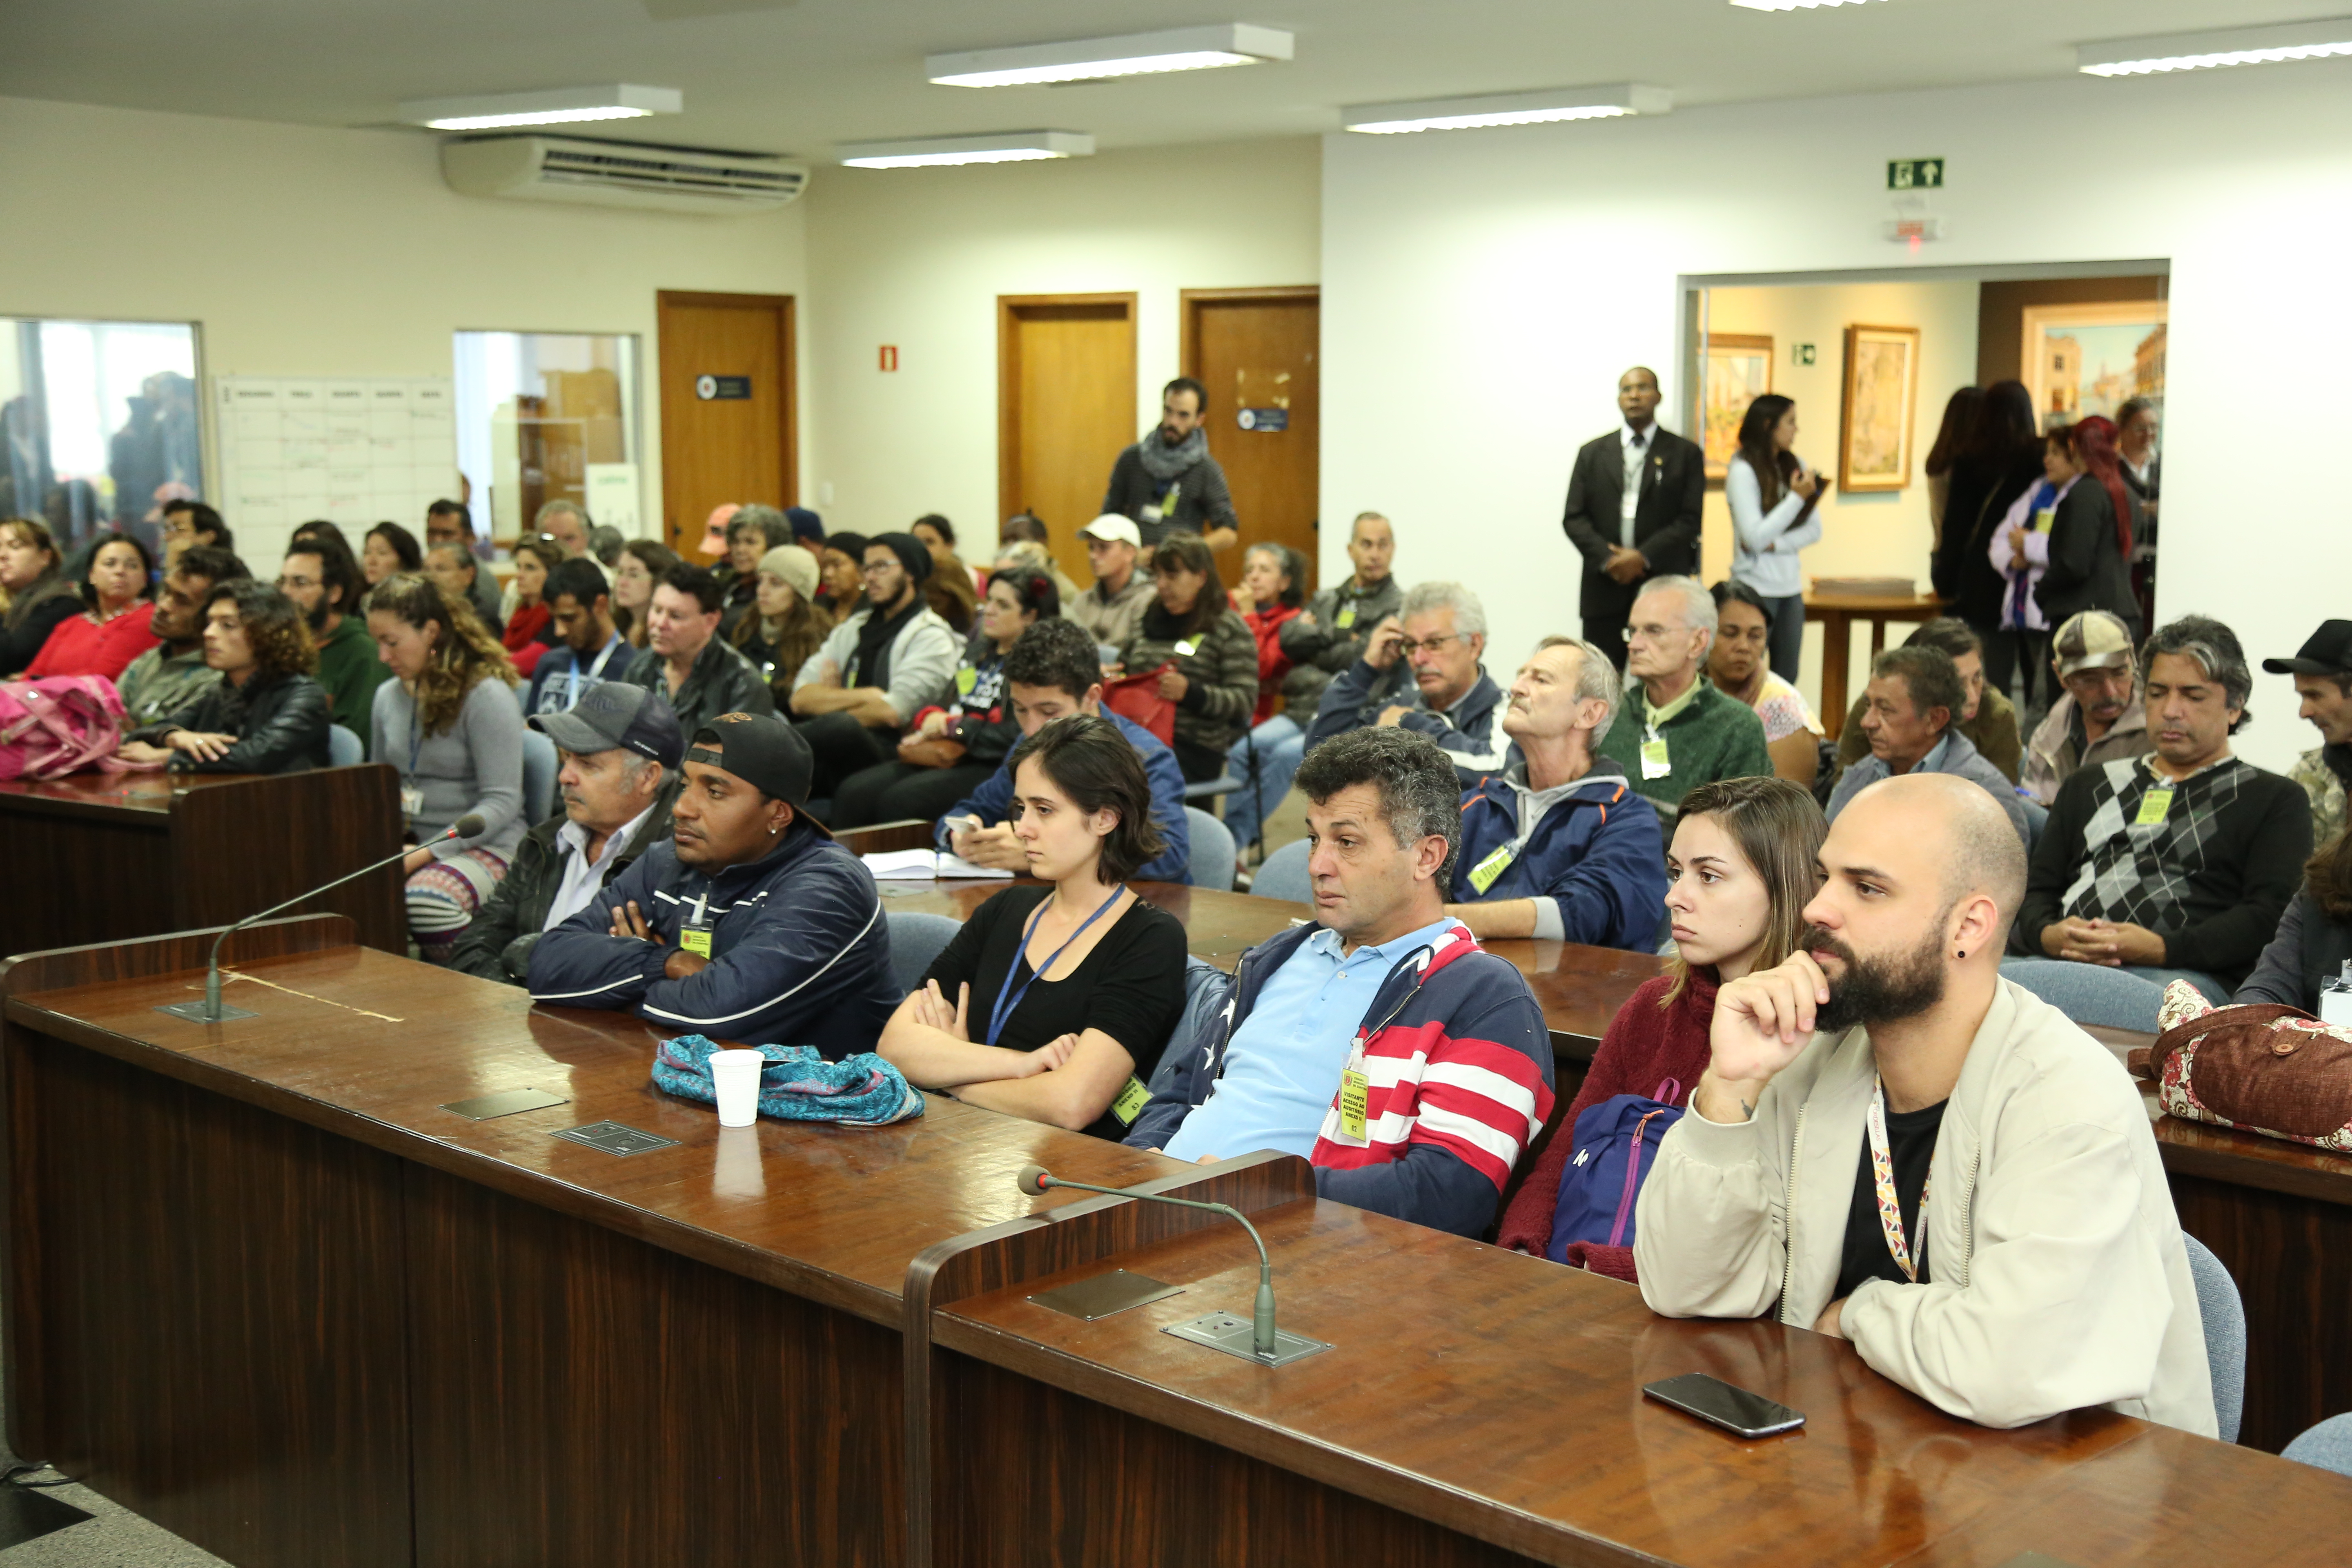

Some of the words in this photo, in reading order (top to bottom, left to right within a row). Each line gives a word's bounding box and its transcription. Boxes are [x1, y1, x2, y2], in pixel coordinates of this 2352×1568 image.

[1118, 1093, 1134, 1107] ANEXO
[1344, 1091, 1364, 1102] VISITANTE
[1343, 1098, 1358, 1107] ACESSO
[1343, 1105, 1364, 1116] AUDITÓRIO
[1345, 1112, 1358, 1120] ANEXO
[1873, 1106, 1881, 1141] TORDESILLAS
